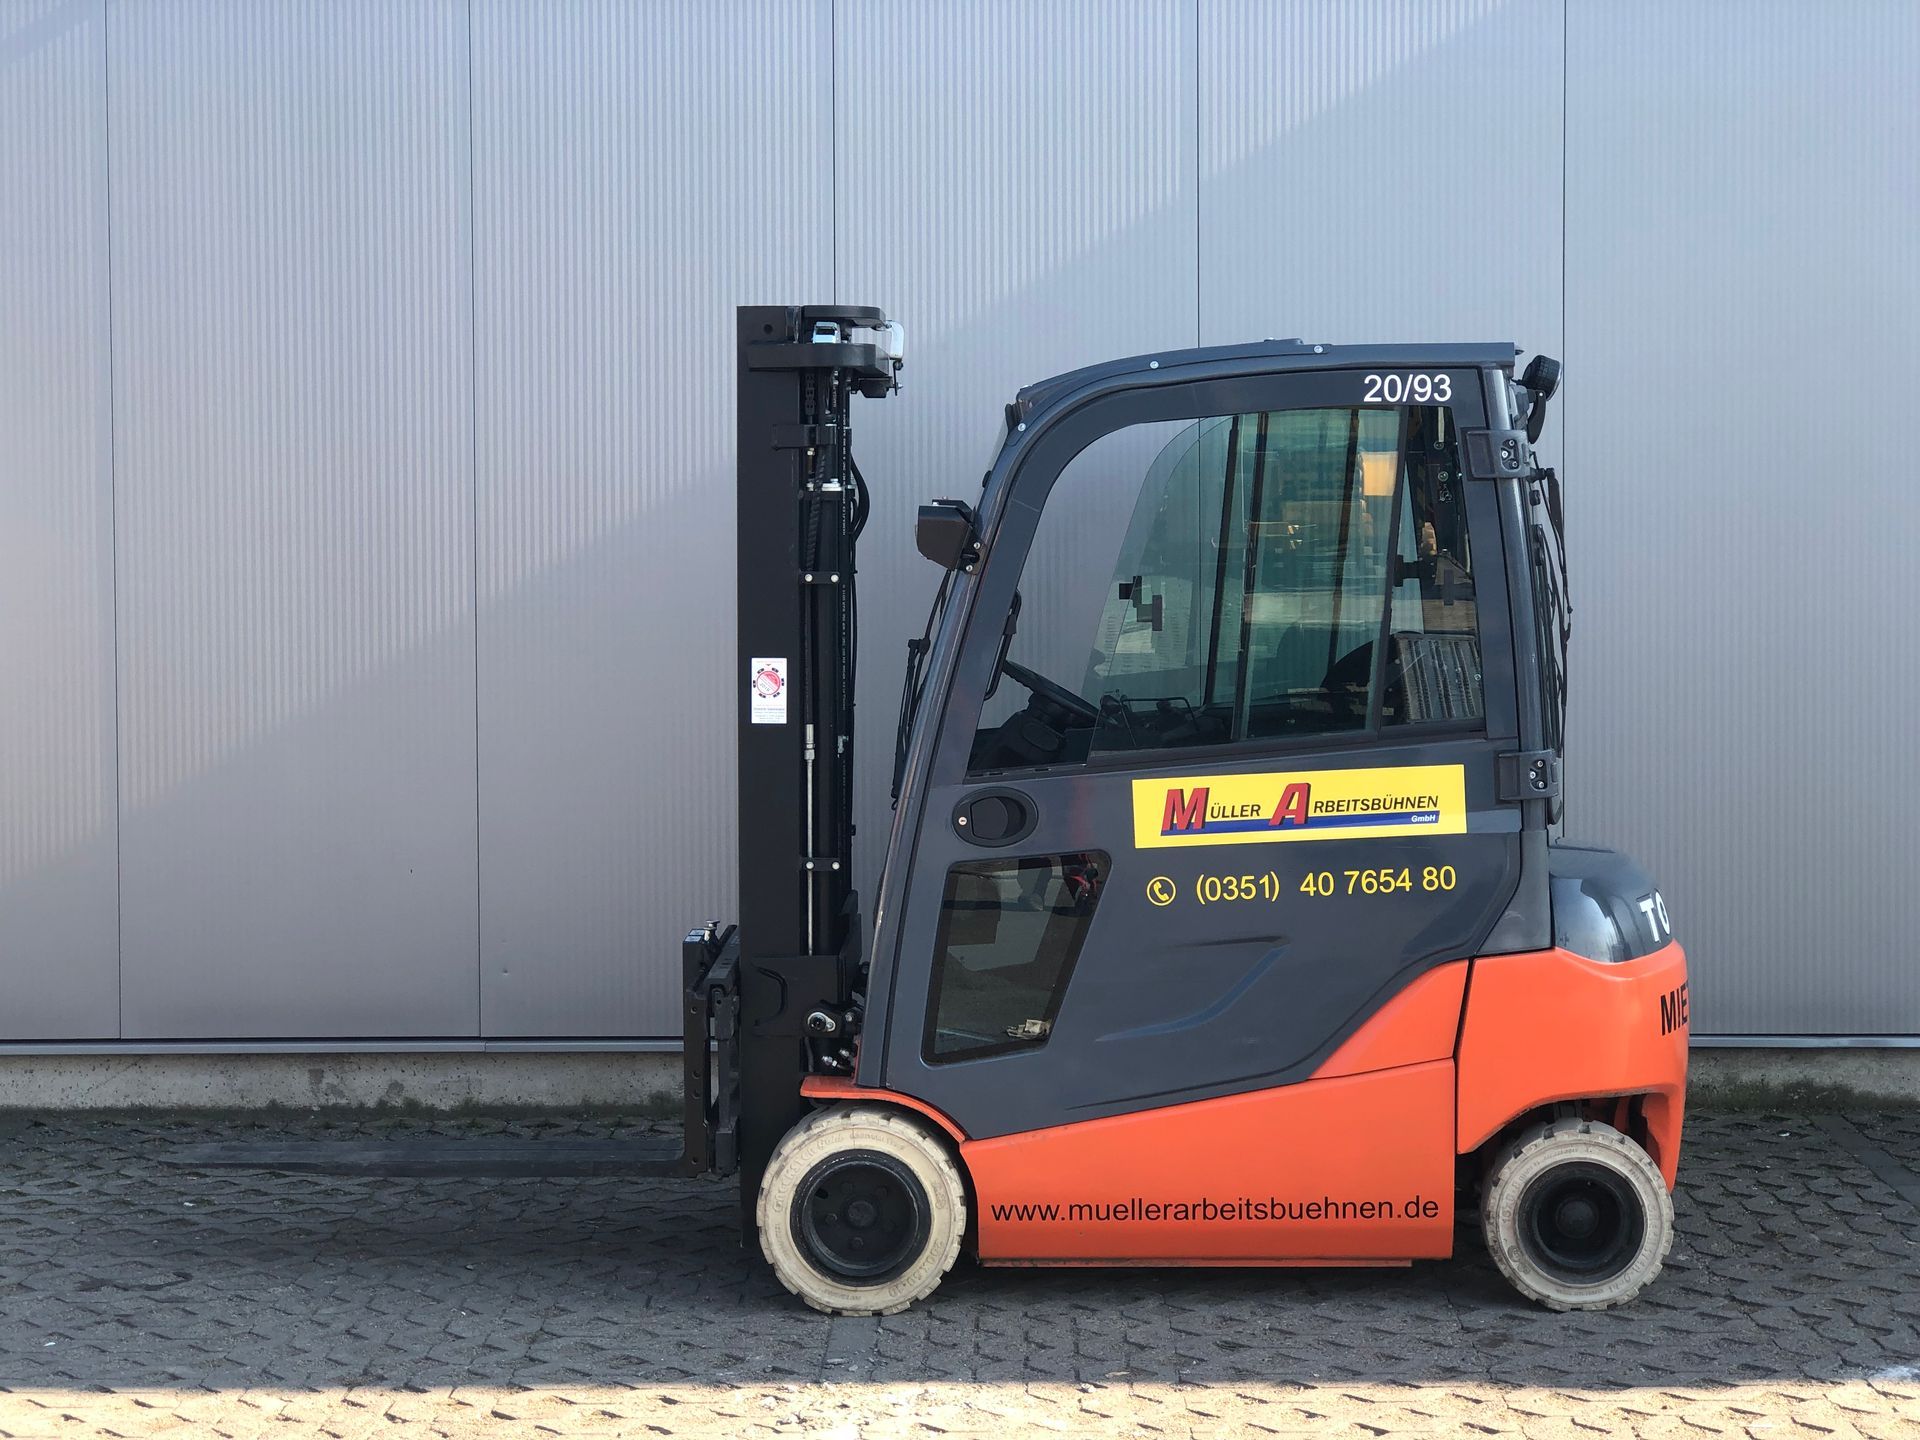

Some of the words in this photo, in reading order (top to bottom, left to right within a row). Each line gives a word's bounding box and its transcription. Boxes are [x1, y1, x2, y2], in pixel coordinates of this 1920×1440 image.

[1363, 374, 1452, 403] 20/93
[1161, 787, 1262, 832] MÜLLER
[1269, 782, 1439, 825] ARBEITSBÜHNEN
[1411, 813, 1437, 824] GmbH
[1196, 871, 1280, 904] (0351)
[1299, 871, 1335, 897] 40
[1345, 867, 1413, 895] 7654
[1422, 865, 1457, 892] 80
[1660, 979, 1688, 1036] MIE
[990, 1194, 1439, 1222] www.muellerarbeitsbuehnen.de
